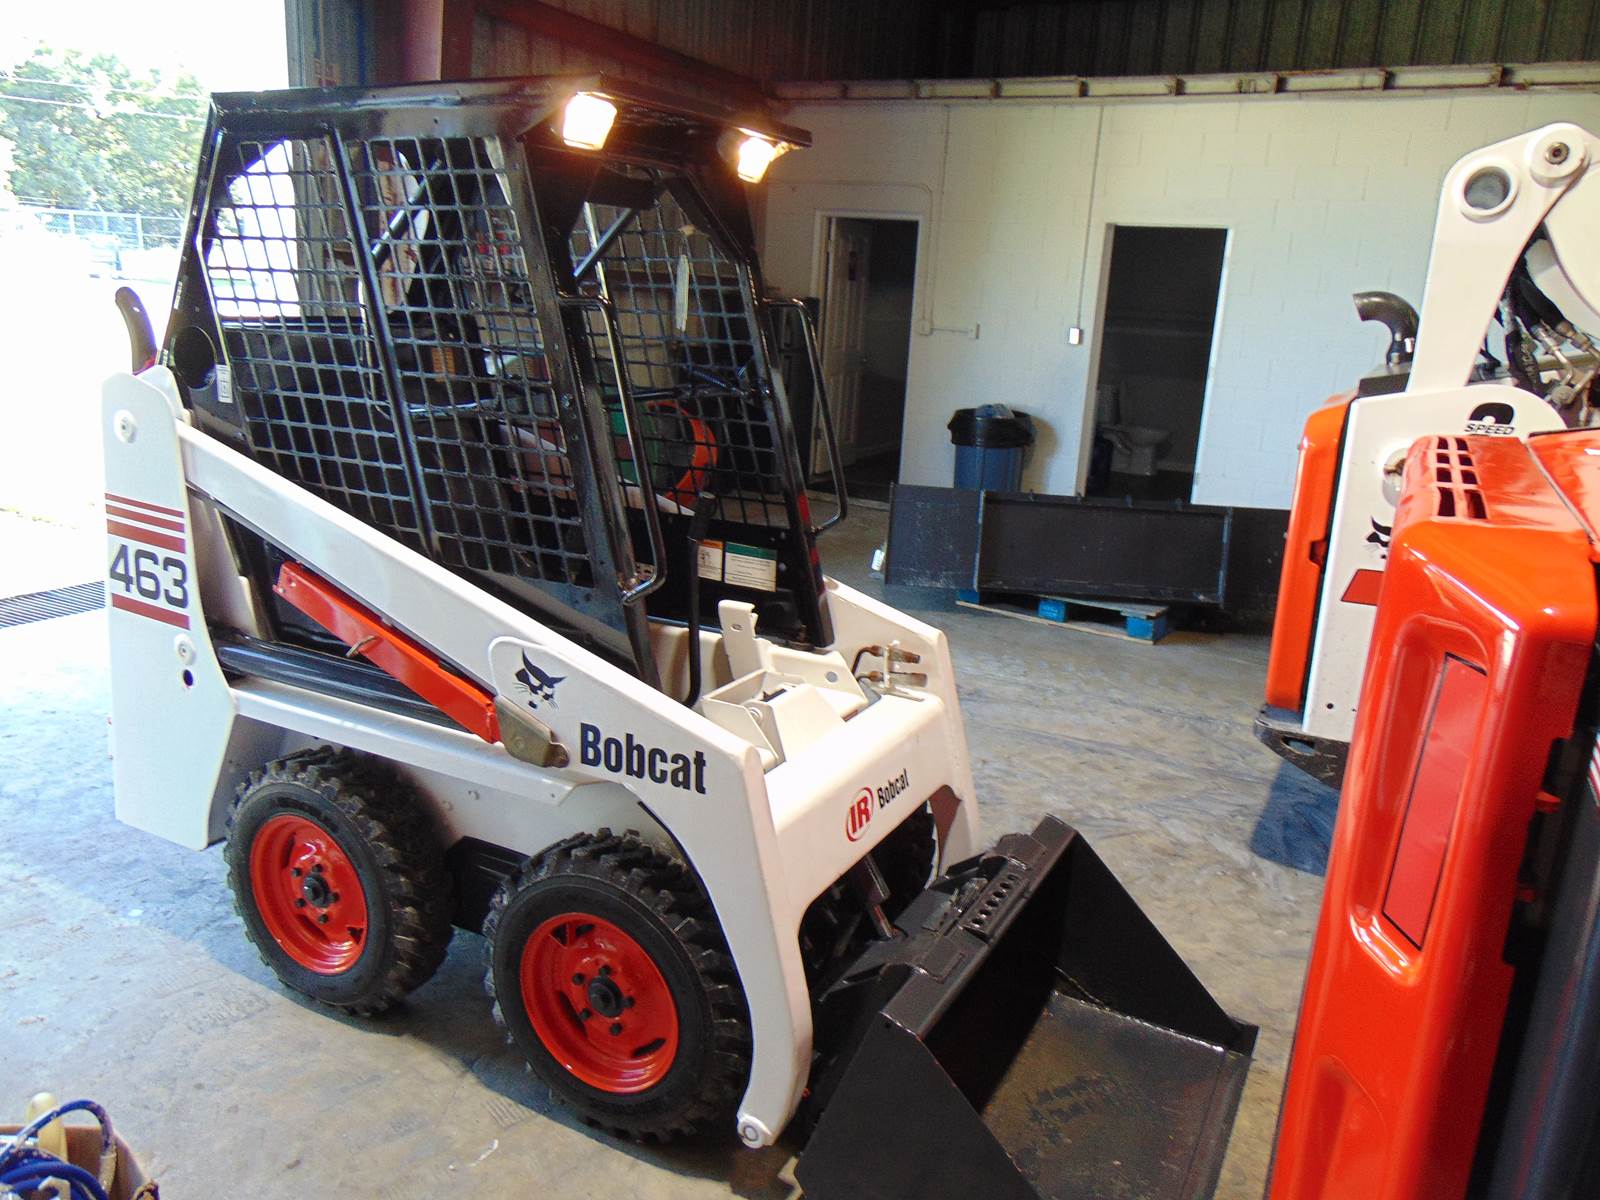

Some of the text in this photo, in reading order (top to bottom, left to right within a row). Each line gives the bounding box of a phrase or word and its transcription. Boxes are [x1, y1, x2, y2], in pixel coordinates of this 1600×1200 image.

[1464, 423, 1515, 435] SPEED
[110, 543, 189, 609] 463
[580, 722, 706, 795] Bobcat
[850, 768, 909, 834] IR Bobcat
